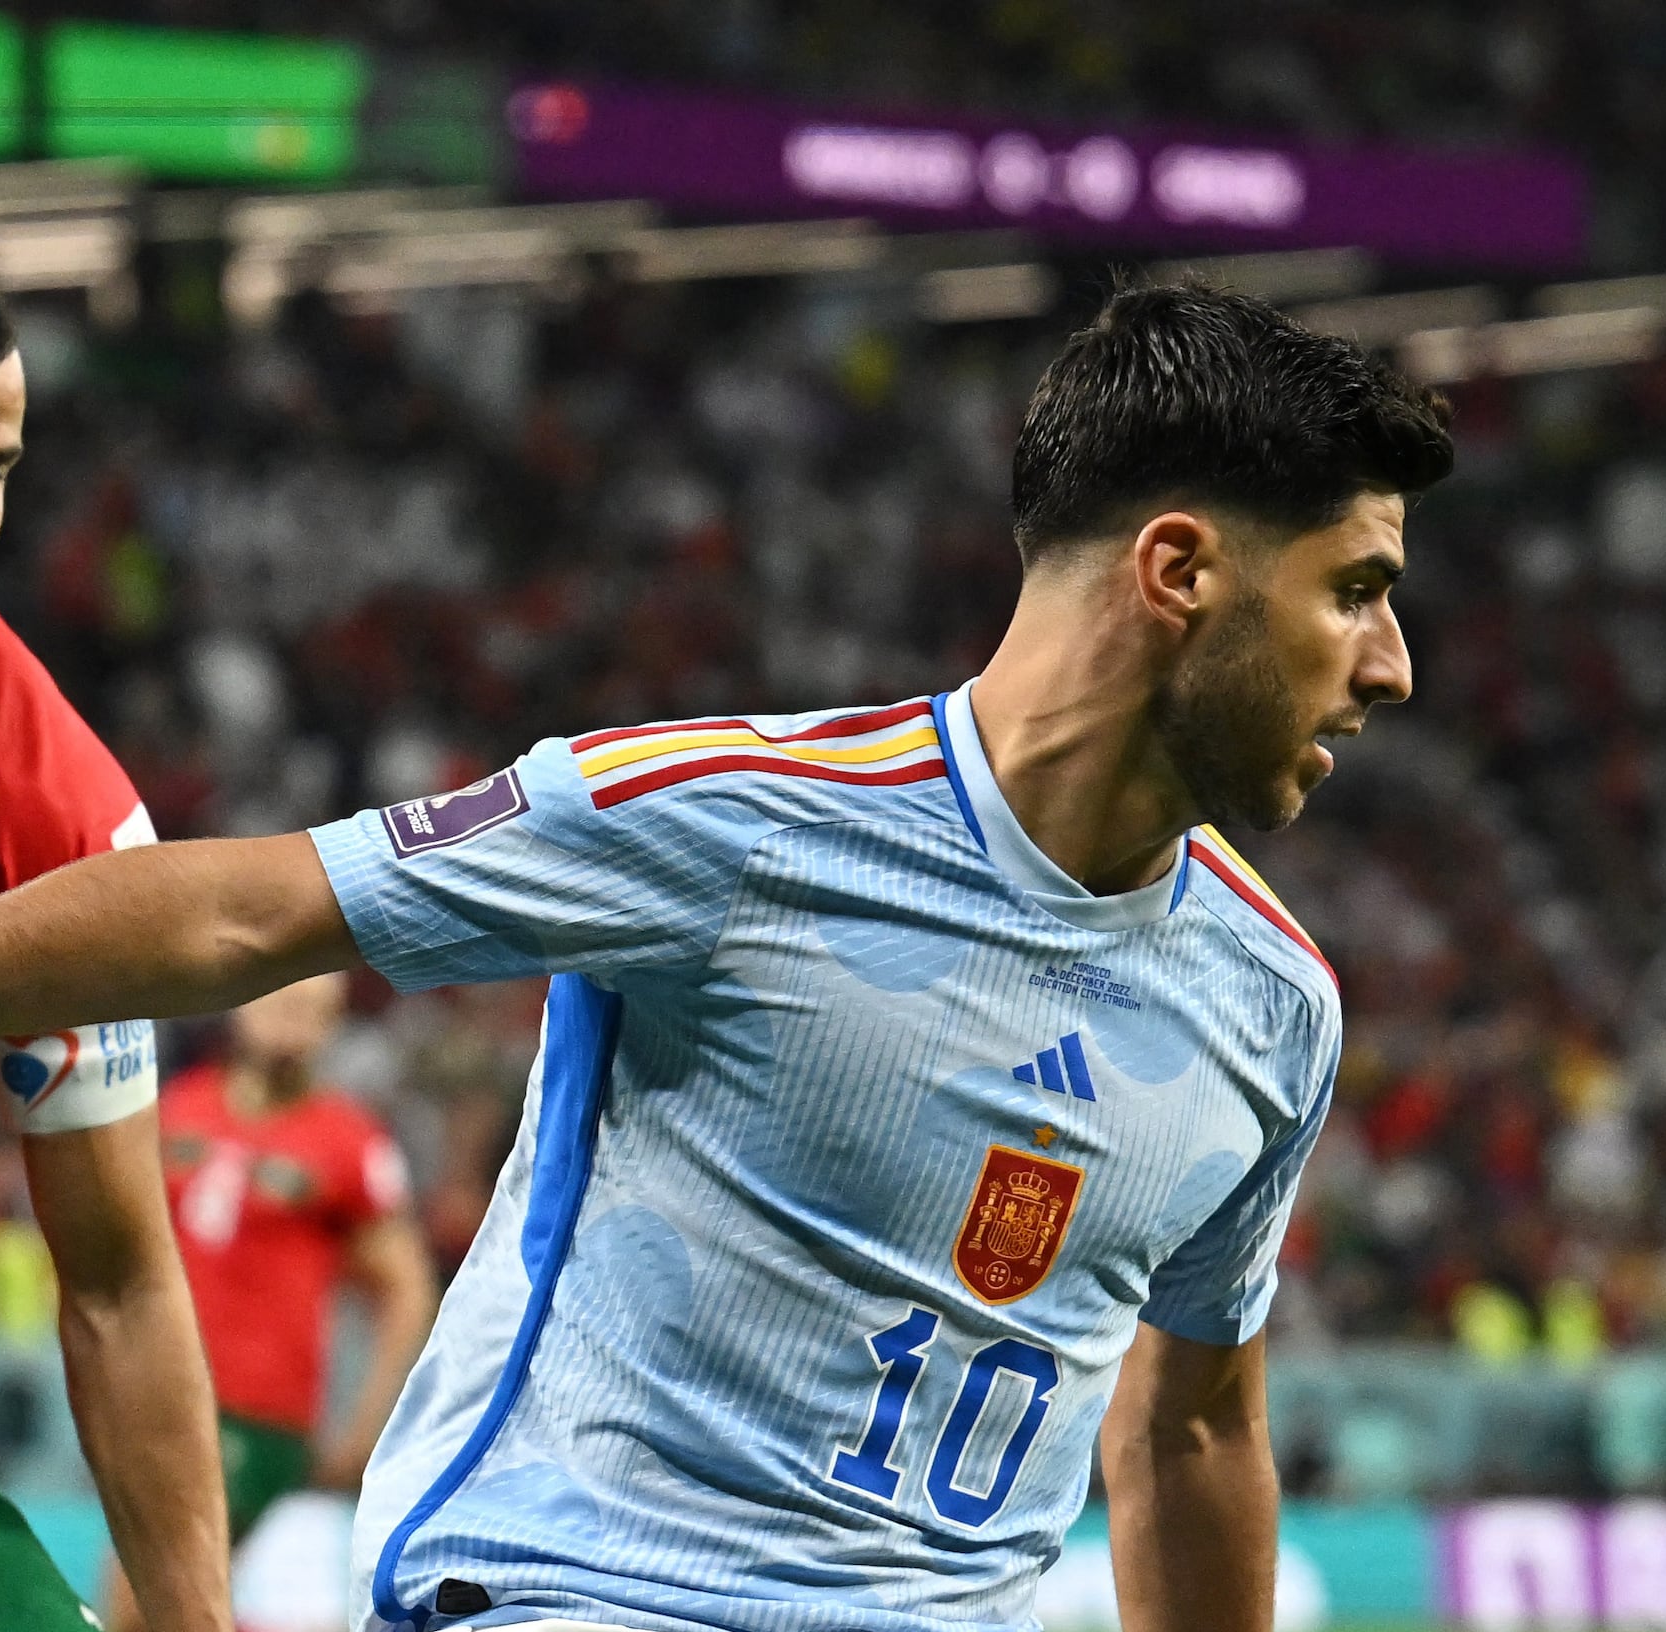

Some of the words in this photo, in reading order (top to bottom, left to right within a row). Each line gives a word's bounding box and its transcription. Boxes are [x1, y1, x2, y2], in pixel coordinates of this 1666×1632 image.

[1045, 966, 1057, 978] 06
[1060, 969, 1105, 990] DECEMBER
[1107, 982, 1131, 997] 2022
[1072, 961, 1111, 979] MOROCCO
[1029, 974, 1079, 996] EDUCATION
[1080, 987, 1101, 1001] CITY
[1103, 993, 1141, 1012] STADIUM
[825, 1302, 1063, 1532] 10
